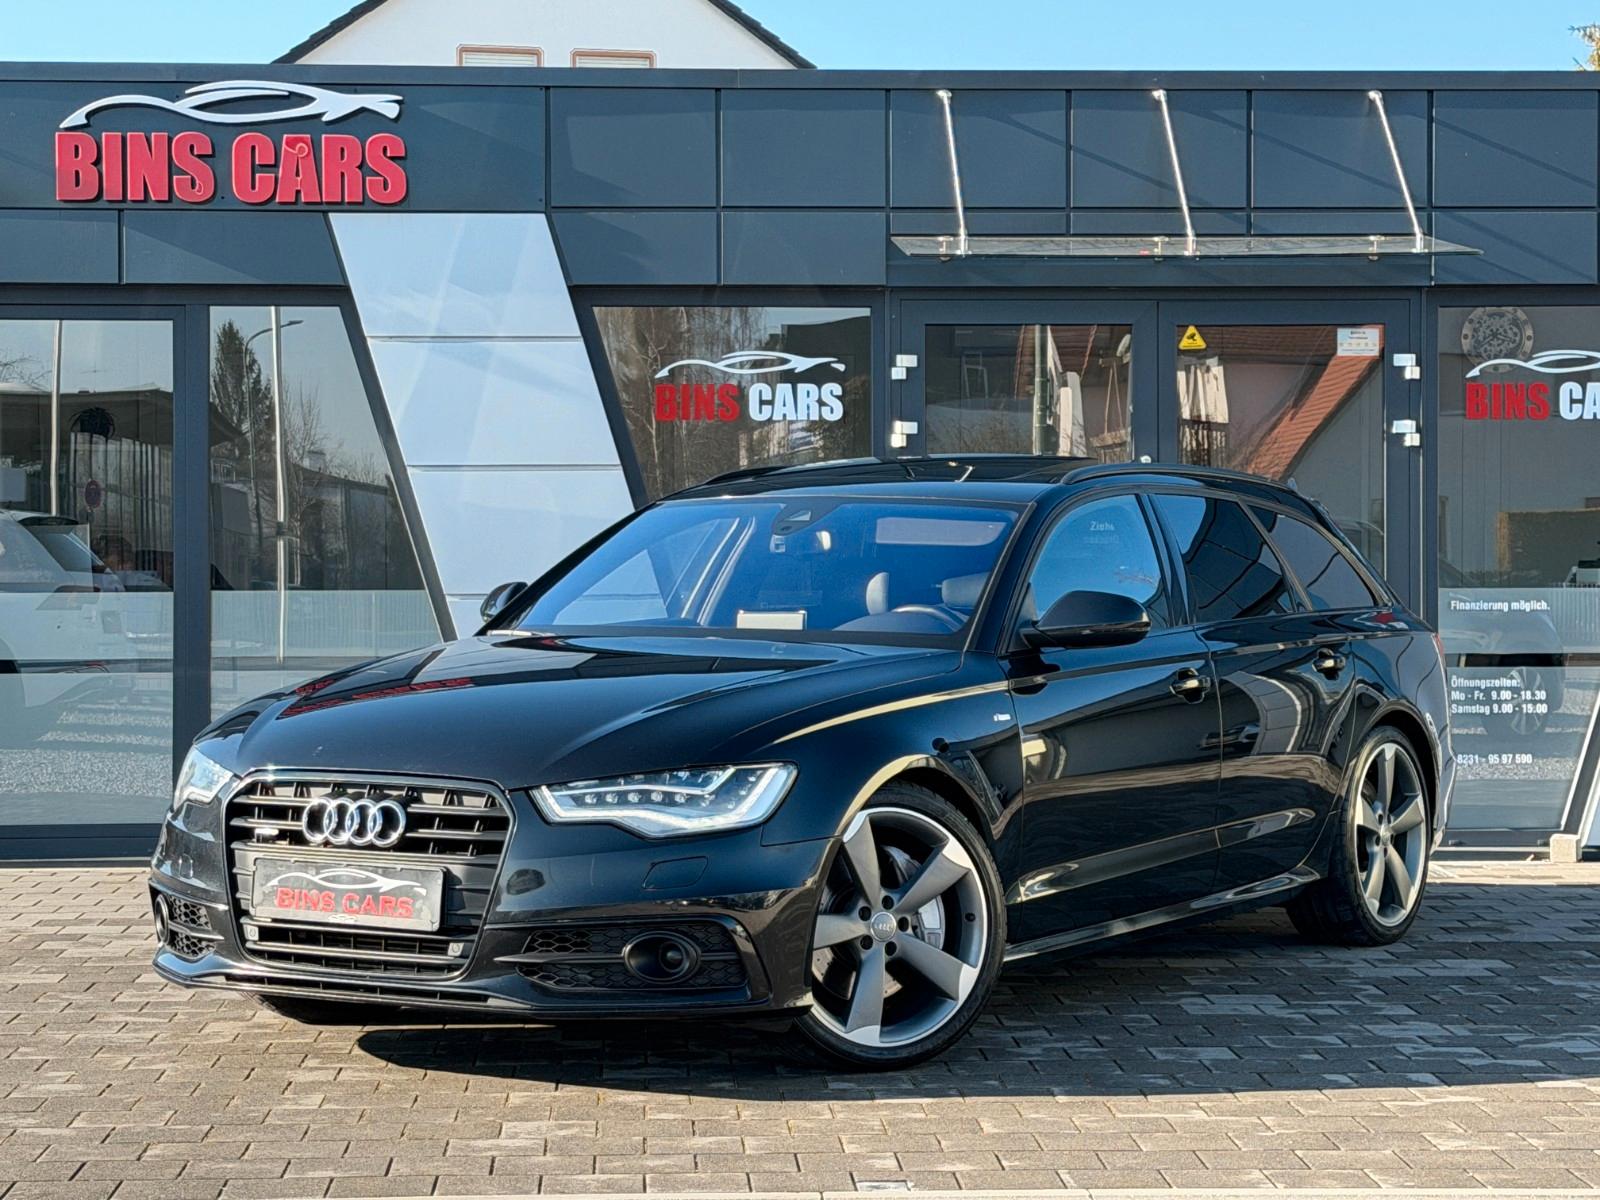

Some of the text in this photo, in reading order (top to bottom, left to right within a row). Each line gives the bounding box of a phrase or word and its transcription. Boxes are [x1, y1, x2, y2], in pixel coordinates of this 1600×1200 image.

[55, 131, 409, 205] BINS CARS
[654, 382, 844, 422] BINS CARS
[1465, 381, 1551, 421] BINS
[1450, 599, 1550, 612] Finanzierung möglich.
[1451, 675, 1520, 689] Öffnungszeiten:
[1451, 690, 1465, 700] Mo
[1474, 690, 1486, 700] Fr.
[1491, 690, 1512, 700] 9.00
[1520, 690, 1547, 700] 18.30
[1451, 703, 1490, 715] Samstag
[1492, 703, 1513, 714] 9.00
[1488, 754, 1499, 764] 95
[1501, 754, 1513, 764] 97
[1515, 754, 1532, 764] 590
[274, 887, 415, 919] BINS CARS
